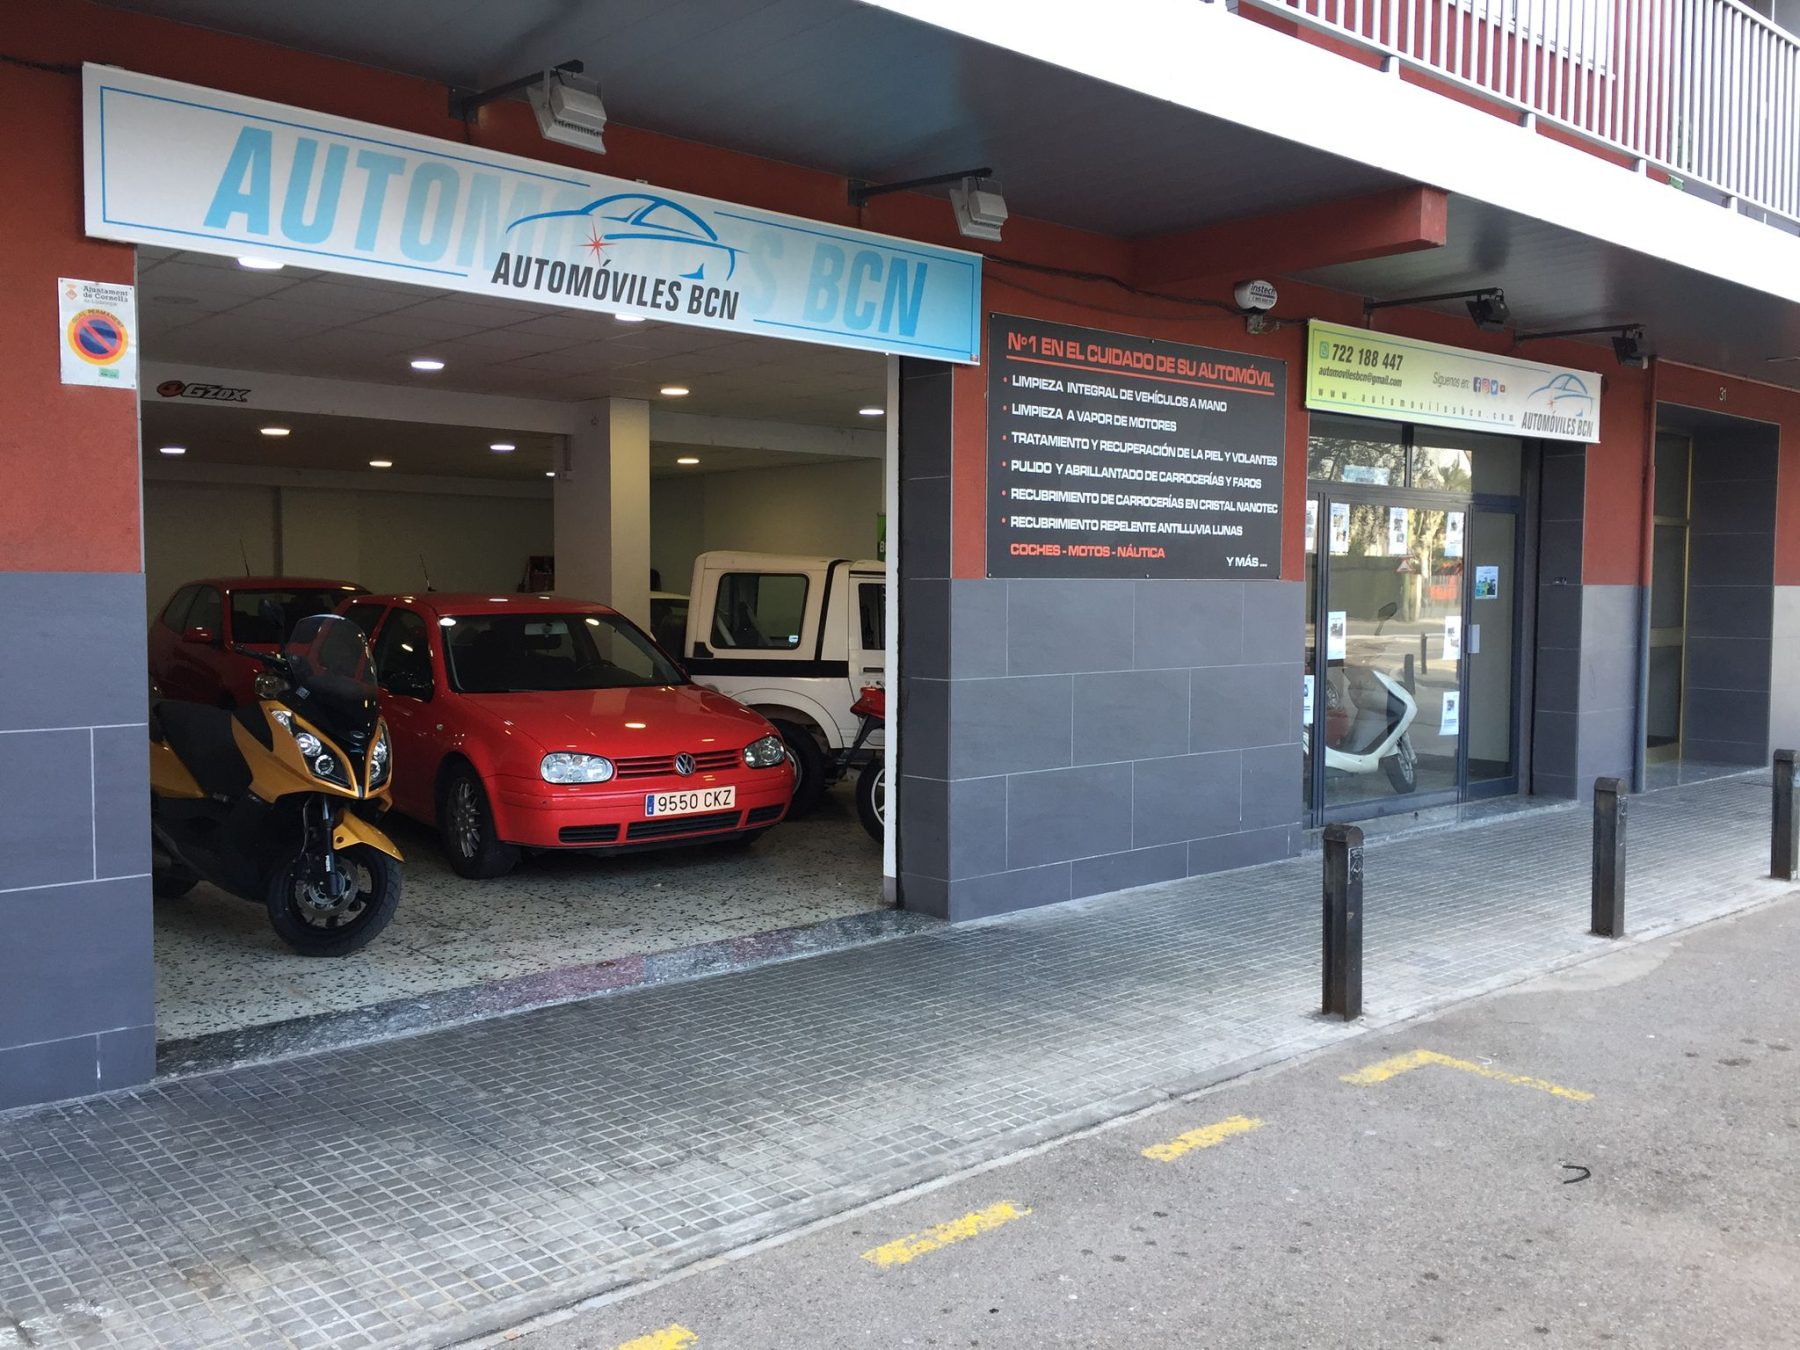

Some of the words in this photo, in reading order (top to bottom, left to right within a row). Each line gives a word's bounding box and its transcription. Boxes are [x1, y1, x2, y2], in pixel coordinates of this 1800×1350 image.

[83, 286, 128, 296] Ajuntament
[492, 252, 680, 312] AUTOMÓVILES
[688, 284, 739, 321] BCN
[803, 241, 928, 338] BCN
[1041, 338, 1063, 357] EN
[1067, 342, 1084, 360] EL
[1087, 344, 1153, 370] CUIDADO
[1157, 356, 1174, 373] DE
[1178, 358, 1196, 376] SU
[1199, 364, 1273, 387] AUTOMÓVIL
[1332, 344, 1353, 363] 722
[1358, 349, 1378, 367] 188
[1383, 354, 1403, 371] 447
[1318, 367, 1402, 387] automovilesbcn@gmail.com
[1012, 376, 1062, 392] LIMPIEZA
[1067, 382, 1118, 399] INTEGRAL
[1120, 388, 1133, 400] DE
[1135, 390, 1188, 407] VEHÍCULOS
[1190, 398, 1197, 408] A
[1198, 399, 1227, 412] MANO
[1012, 404, 1062, 420] LIMPIEZA
[1067, 410, 1075, 420] A
[1076, 410, 1112, 425] VAPOR
[1114, 416, 1128, 426] DE
[1129, 416, 1176, 432] MOTORES
[1522, 410, 1575, 436] AUTOMÓVILES
[1577, 420, 1592, 437] BCN
[1012, 432, 1089, 449] TRATAMIENTO
[1091, 439, 1099, 450] Y
[1100, 440, 1176, 458] RECUPERACIÓN
[1178, 447, 1189, 458] DE
[1191, 448, 1202, 460] LA
[1204, 449, 1223, 462] PIEL
[1224, 452, 1230, 462] Y
[1232, 452, 1277, 466] VOLANTES
[1012, 460, 1051, 474] PULIDO
[1056, 464, 1063, 475] Y
[1065, 464, 1143, 481] ABRILLANTADO
[1145, 470, 1158, 482] DE
[1159, 470, 1223, 486] CARROCERÍAS
[1226, 475, 1232, 486] Y
[1233, 476, 1261, 488] FAROS
[1011, 488, 1099, 504] RECUBRIMIENTO
[1101, 494, 1114, 504] DE
[1116, 494, 1184, 509] CARROCERÍAS
[1186, 498, 1198, 510] EN
[1200, 499, 1235, 511] CRISTAL
[1237, 500, 1278, 513] NANOTEC
[1011, 516, 1099, 530] RECUBRIMIENTO
[1100, 519, 1156, 532] REPELENTE
[1158, 522, 1210, 534] ANTILLUVIA
[1212, 524, 1242, 536] LUNAS
[1010, 543, 1060, 556] COCHES
[1069, 545, 1110, 557] MOTOS
[1118, 543, 1164, 558] NÁUTICA
[1227, 556, 1233, 566] Y
[658, 793, 698, 812] 9550
[704, 790, 731, 808] CKZ
